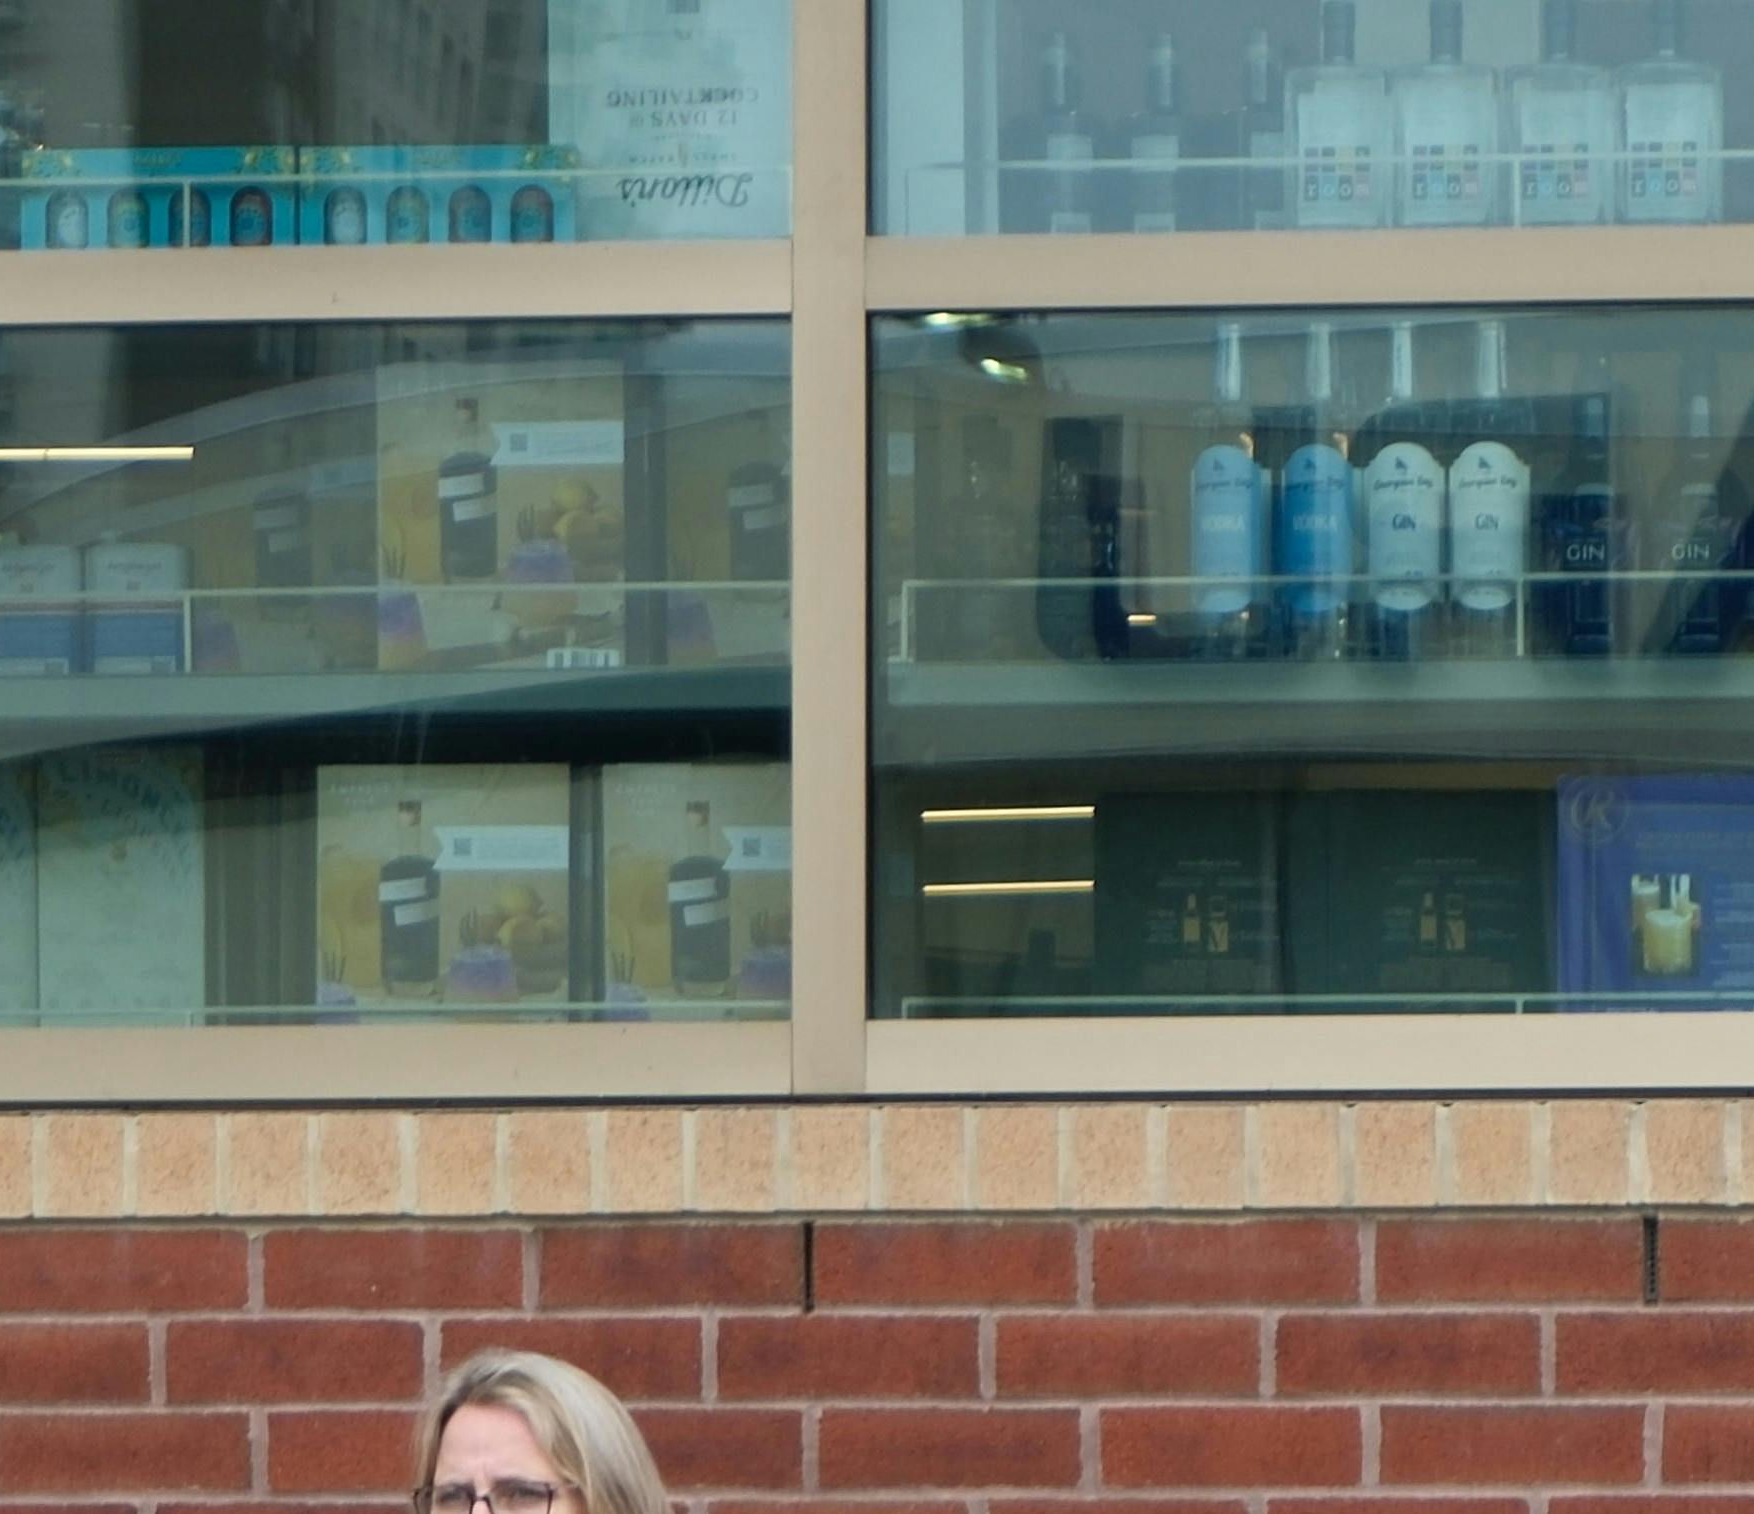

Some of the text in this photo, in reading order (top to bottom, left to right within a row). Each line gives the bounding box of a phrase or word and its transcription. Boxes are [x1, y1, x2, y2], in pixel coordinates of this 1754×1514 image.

[606, 86, 760, 109] COCKTAILING
[650, 110, 708, 128] DAYS
[716, 109, 738, 127] 12
[616, 172, 755, 208] Dillon's
[1565, 544, 1606, 561] GIN
[1670, 543, 1710, 560] GIN
